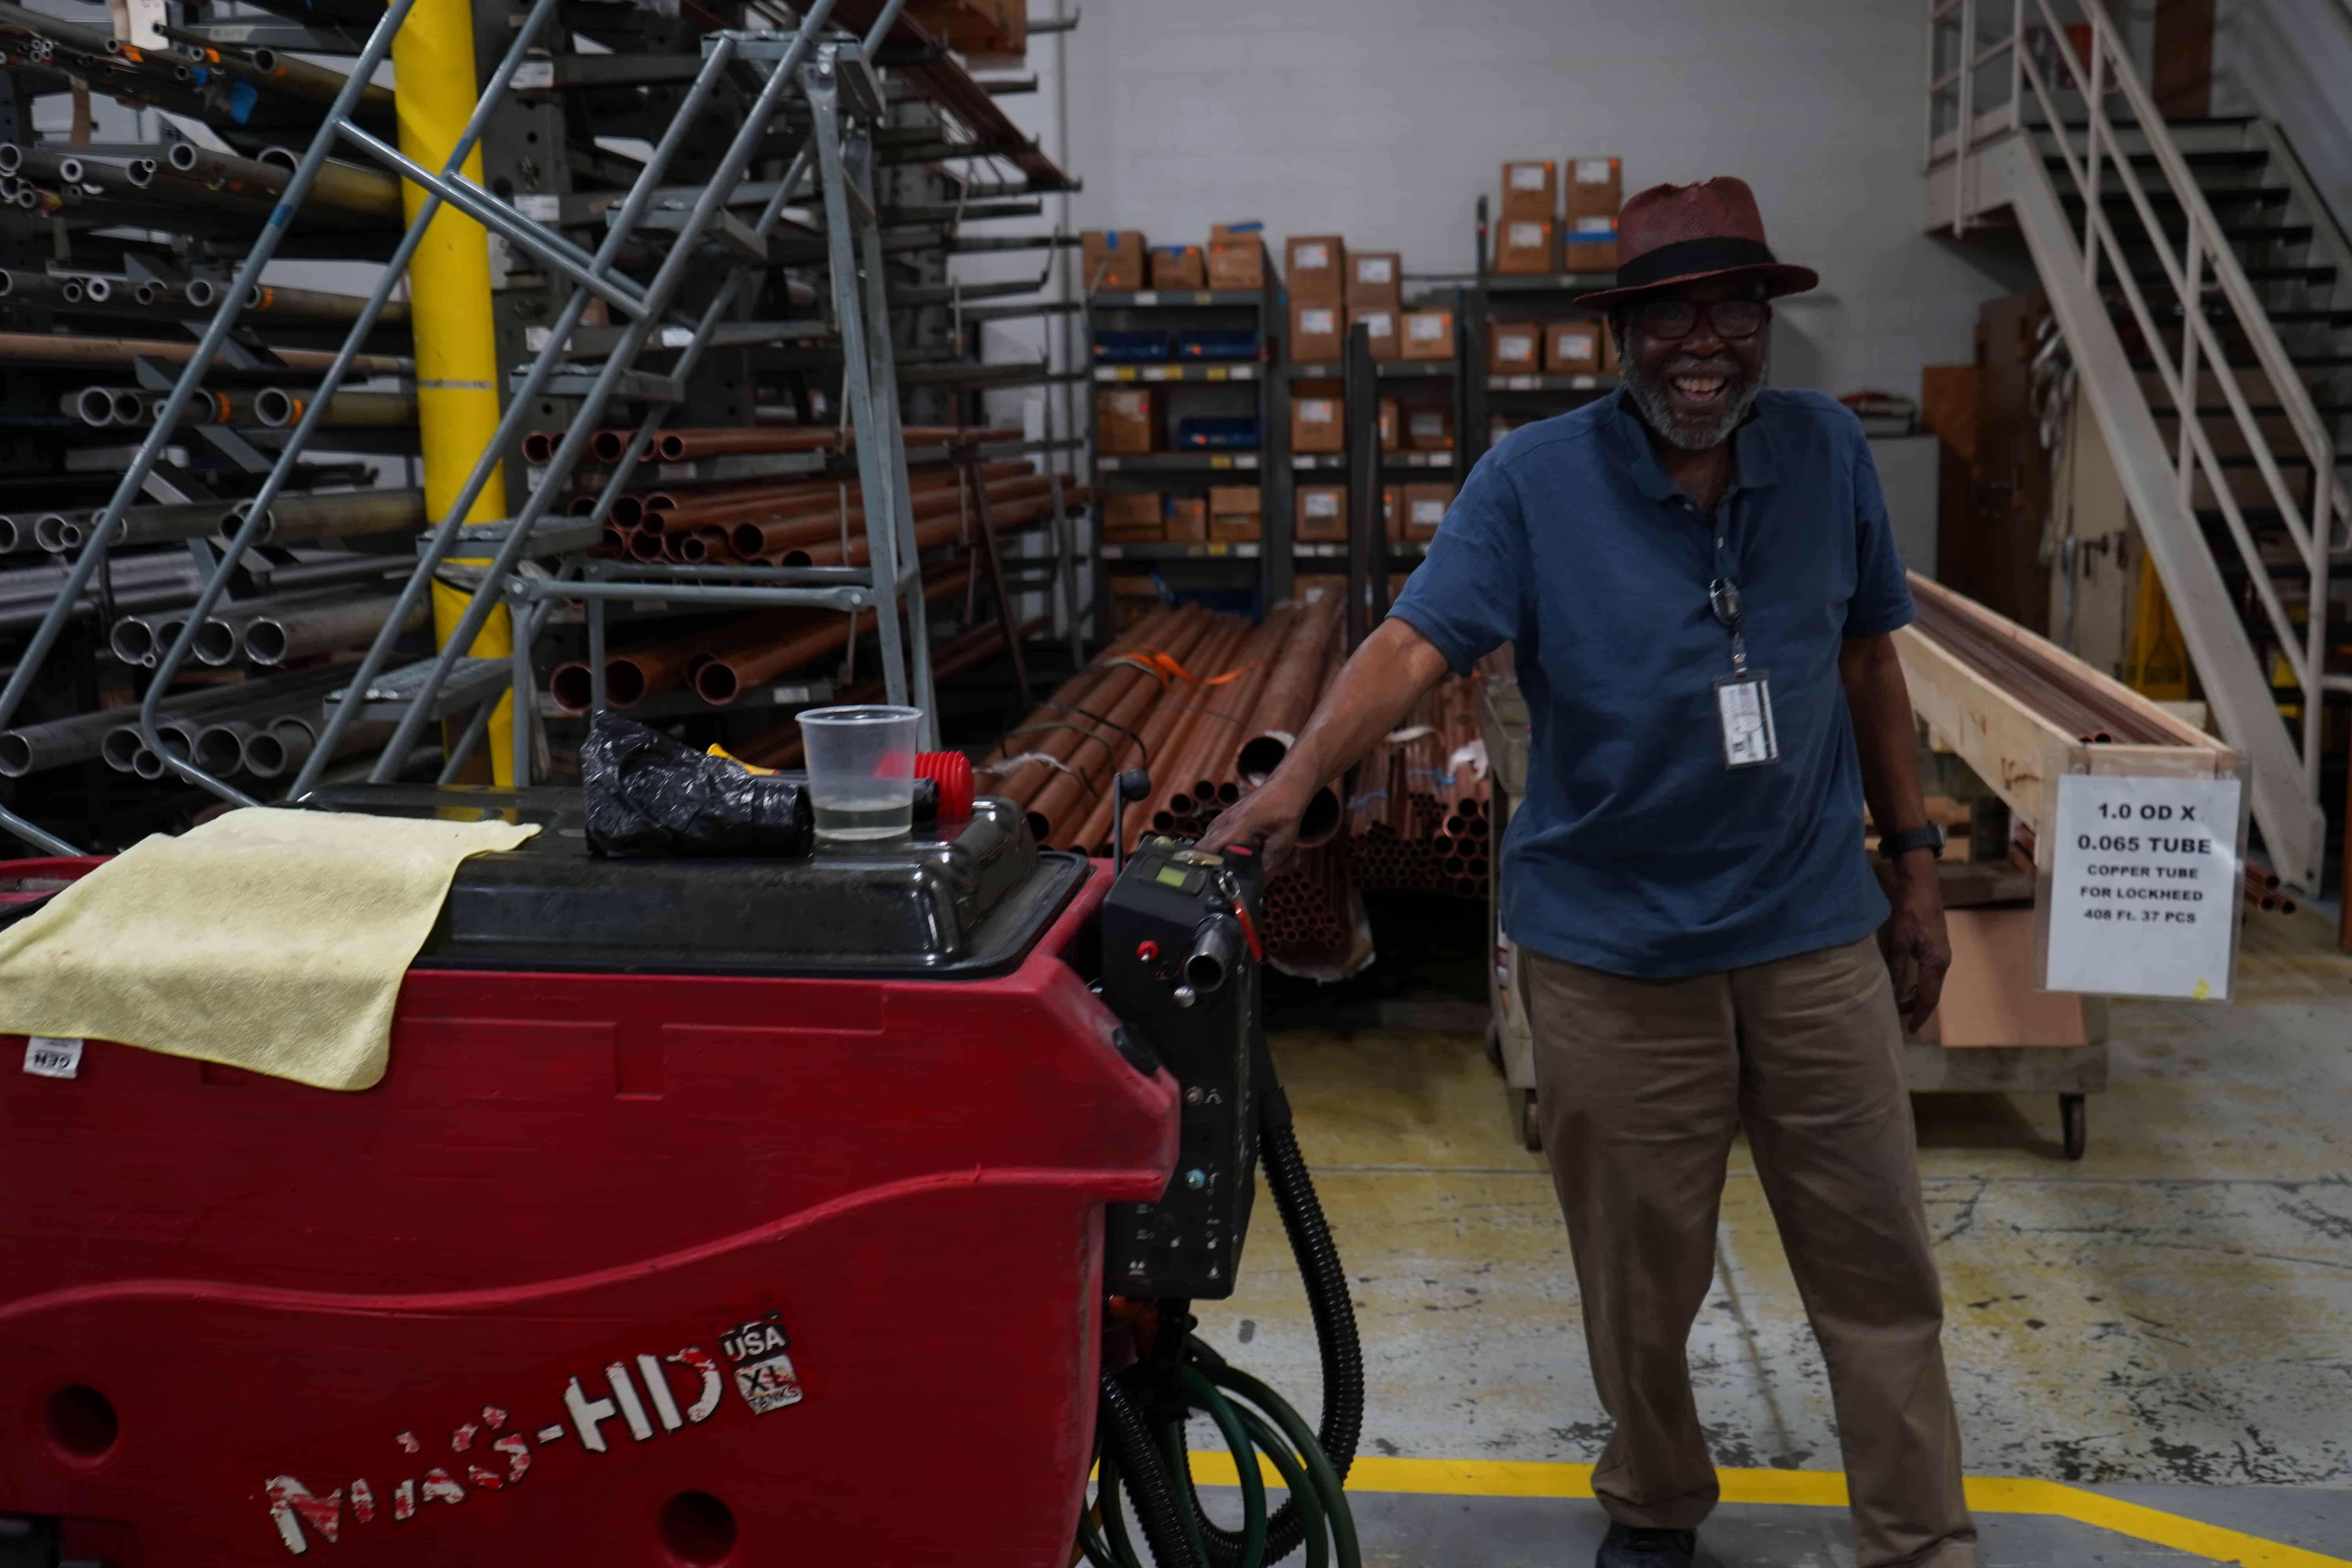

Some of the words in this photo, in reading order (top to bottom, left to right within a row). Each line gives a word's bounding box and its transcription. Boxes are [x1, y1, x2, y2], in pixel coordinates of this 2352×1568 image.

[2099, 802, 2131, 820] 1.0
[2140, 804, 2172, 821] OD
[2181, 805, 2196, 821] X
[2078, 834, 2140, 852] 0.065
[2148, 837, 2211, 855] TUBE
[2087, 864, 2150, 877] COPPER
[2156, 867, 2198, 879] TUBE
[2080, 886, 2111, 899] FOR
[2116, 887, 2203, 901] LOCKHEED
[2083, 908, 2111, 920] 408
[2117, 910, 2136, 921] Ft.
[2141, 911, 2160, 922] 37
[2165, 912, 2196, 924] PCS
[724, 1326, 786, 1361] USA
